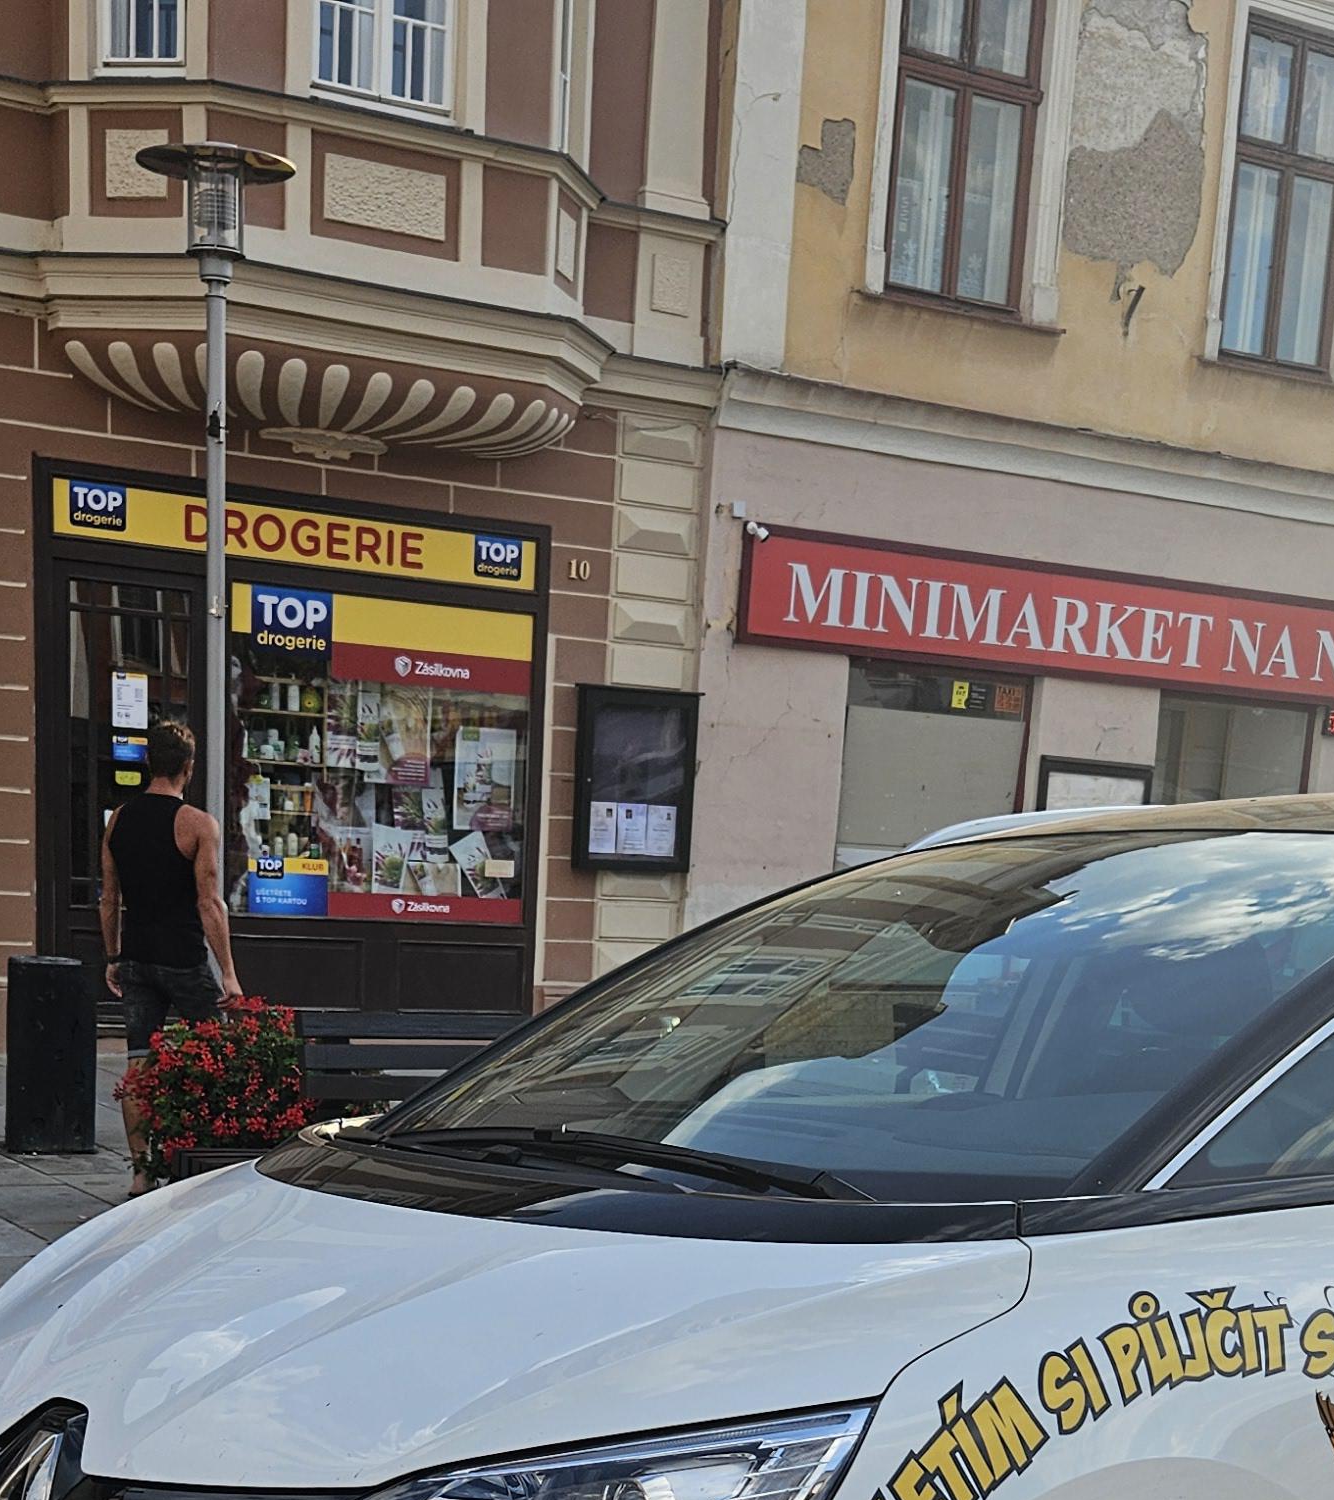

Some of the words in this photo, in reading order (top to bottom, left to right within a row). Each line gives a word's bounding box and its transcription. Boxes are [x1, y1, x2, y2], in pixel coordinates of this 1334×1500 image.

[72, 485, 123, 512] TOP
[72, 509, 123, 528] drogerie
[184, 503, 425, 570] DROGERIE
[477, 539, 519, 564] TOP
[477, 562, 519, 578] drogerie
[568, 558, 591, 580] 10
[256, 593, 328, 630] TOP
[782, 562, 1214, 668] MINIMARKET
[1222, 618, 1299, 680] NA
[256, 630, 326, 652] drogerie
[414, 660, 470, 680] Zásilkovna
[258, 858, 283, 871] TOP
[406, 900, 450, 914] Zásilkovna
[1038, 1336, 1111, 1434] SI
[1097, 1286, 1292, 1406] PŮJČIT
